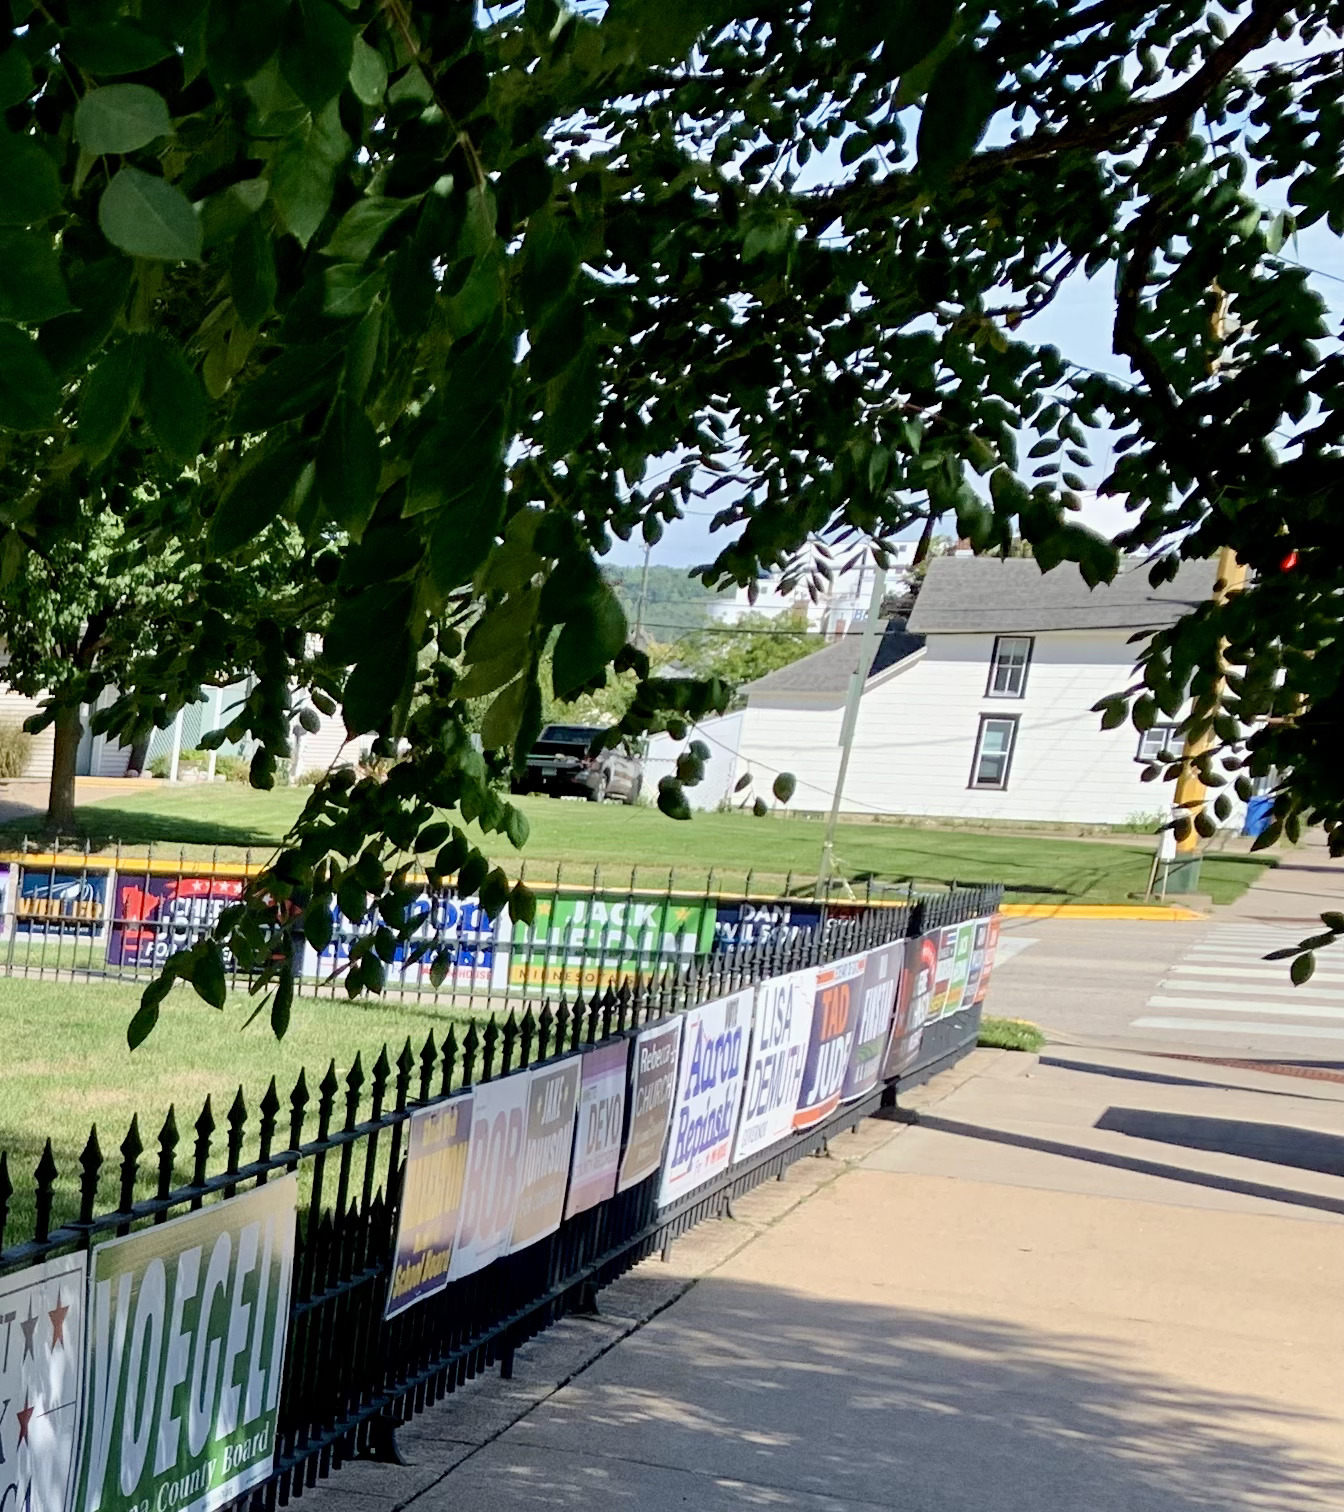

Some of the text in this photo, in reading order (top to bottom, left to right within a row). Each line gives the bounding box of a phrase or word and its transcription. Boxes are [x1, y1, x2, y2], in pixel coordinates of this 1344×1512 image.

[566, 900, 658, 928] JACK
[739, 903, 792, 923] DAN
[760, 984, 794, 1051] LISA
[820, 983, 850, 1042] TAD
[684, 1020, 742, 1101] Aaron
[746, 1042, 807, 1121] DEMUTH
[587, 1093, 622, 1155] DEYO
[671, 1081, 737, 1173] Repinski
[156, 1456, 217, 1512] County
[221, 1420, 270, 1476] Board
